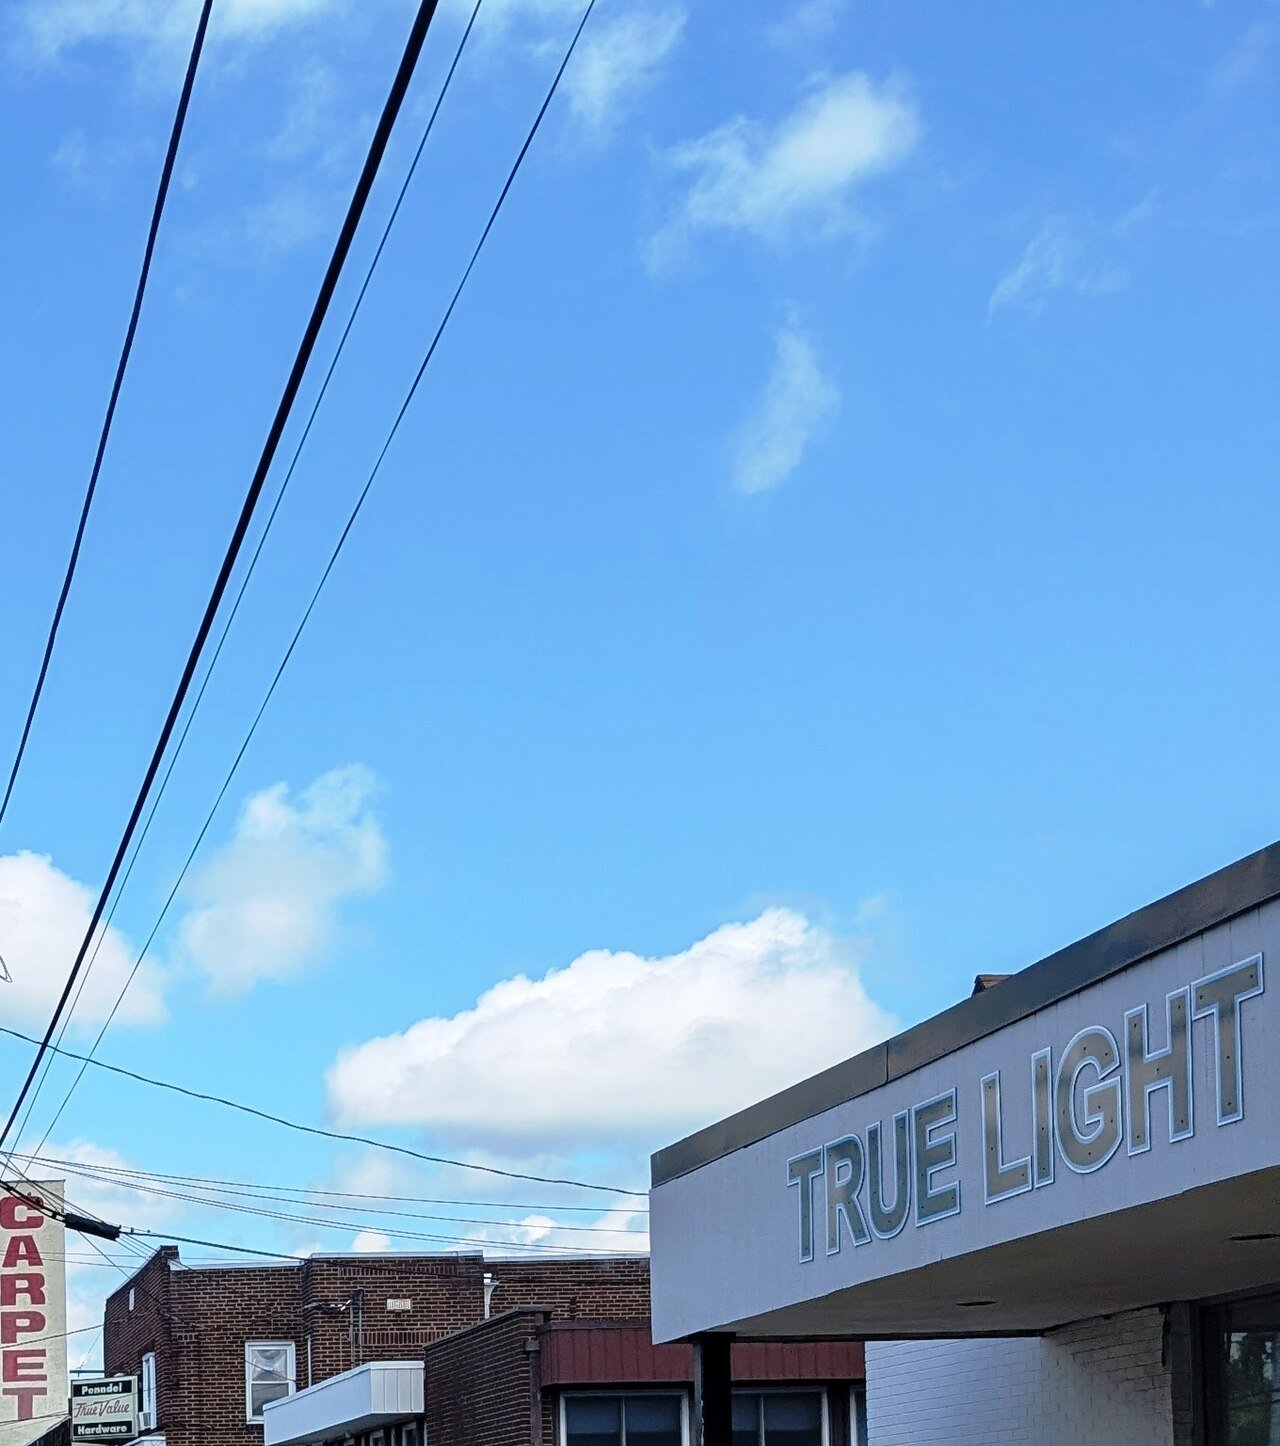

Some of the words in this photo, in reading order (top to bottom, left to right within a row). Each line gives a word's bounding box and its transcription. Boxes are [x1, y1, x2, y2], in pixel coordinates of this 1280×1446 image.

[786, 1086, 961, 1264] TRUE
[979, 951, 1264, 1208] LIGHT
[81, 1382, 123, 1395] Penndel
[73, 1402, 98, 1418] True
[94, 1400, 130, 1417] Value
[77, 1424, 128, 1435] Hardware
